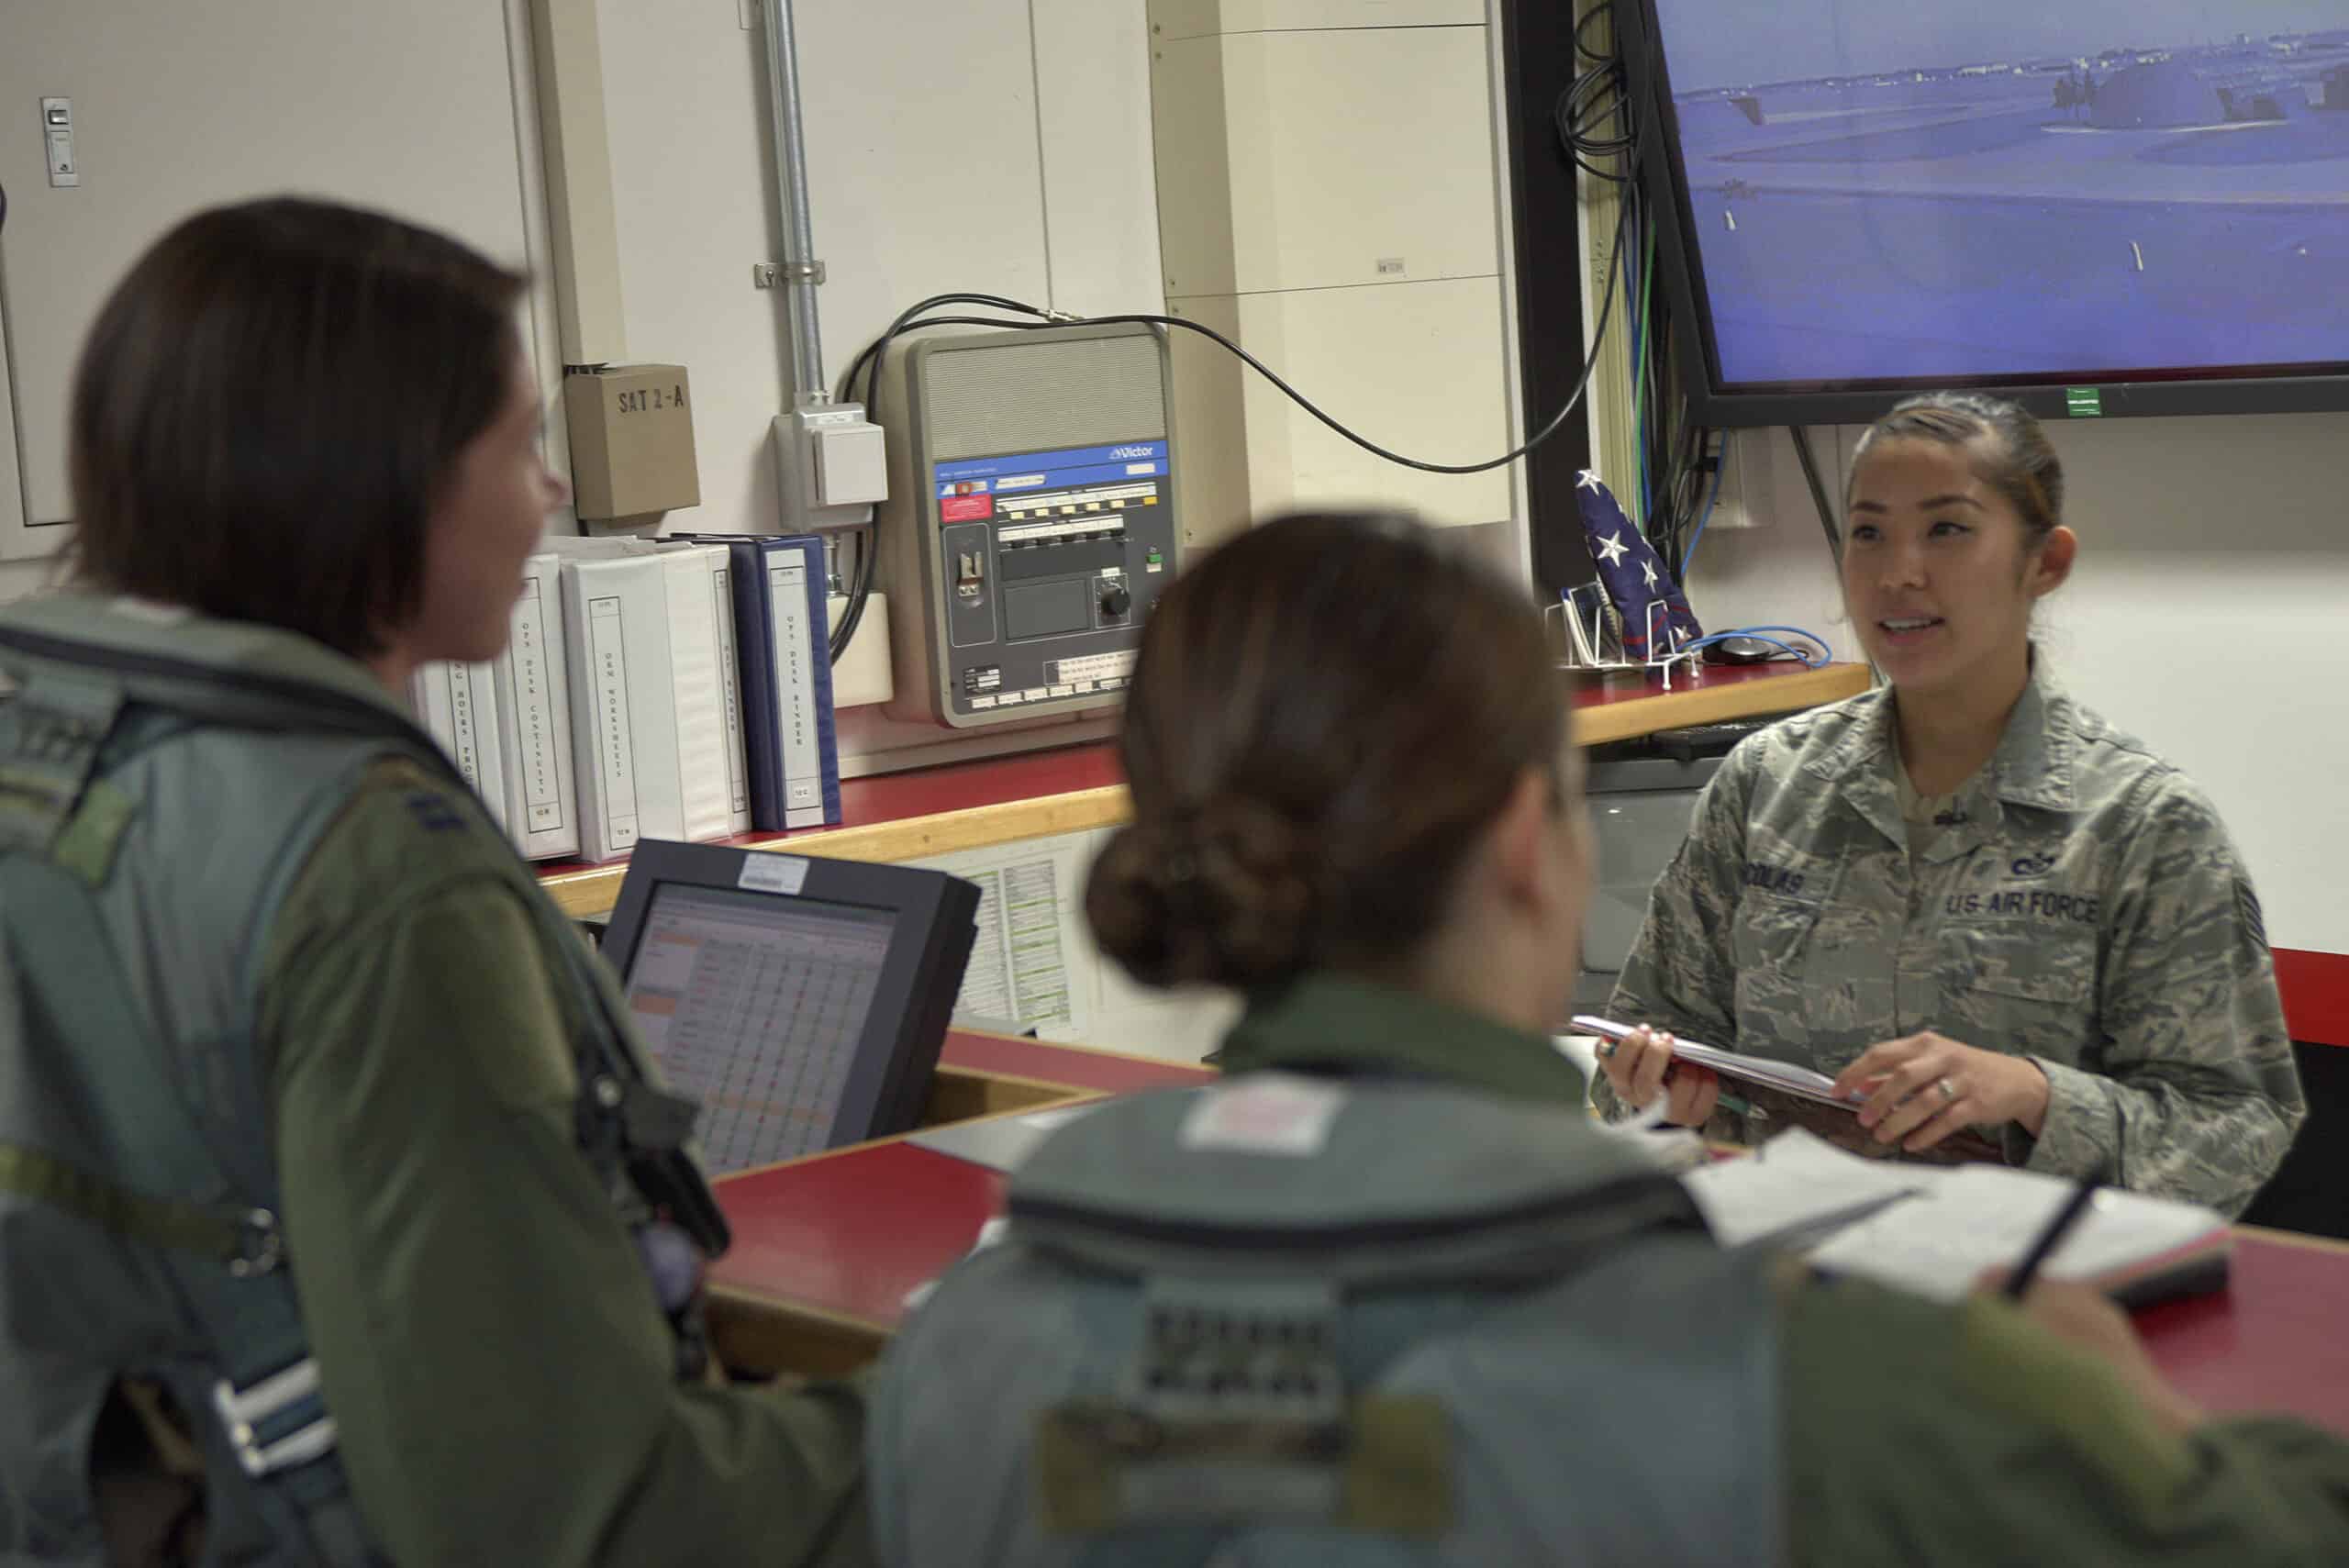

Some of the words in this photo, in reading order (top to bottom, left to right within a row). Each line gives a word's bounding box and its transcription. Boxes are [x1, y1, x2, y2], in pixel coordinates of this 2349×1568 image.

[618, 390, 647, 414] SAT
[1120, 446, 1153, 458] Victor
[608, 689, 623, 777] WORKSHEETS
[793, 695, 803, 746] BINDER
[1988, 892, 2026, 914] AIR
[2029, 892, 2099, 924] FORCE
